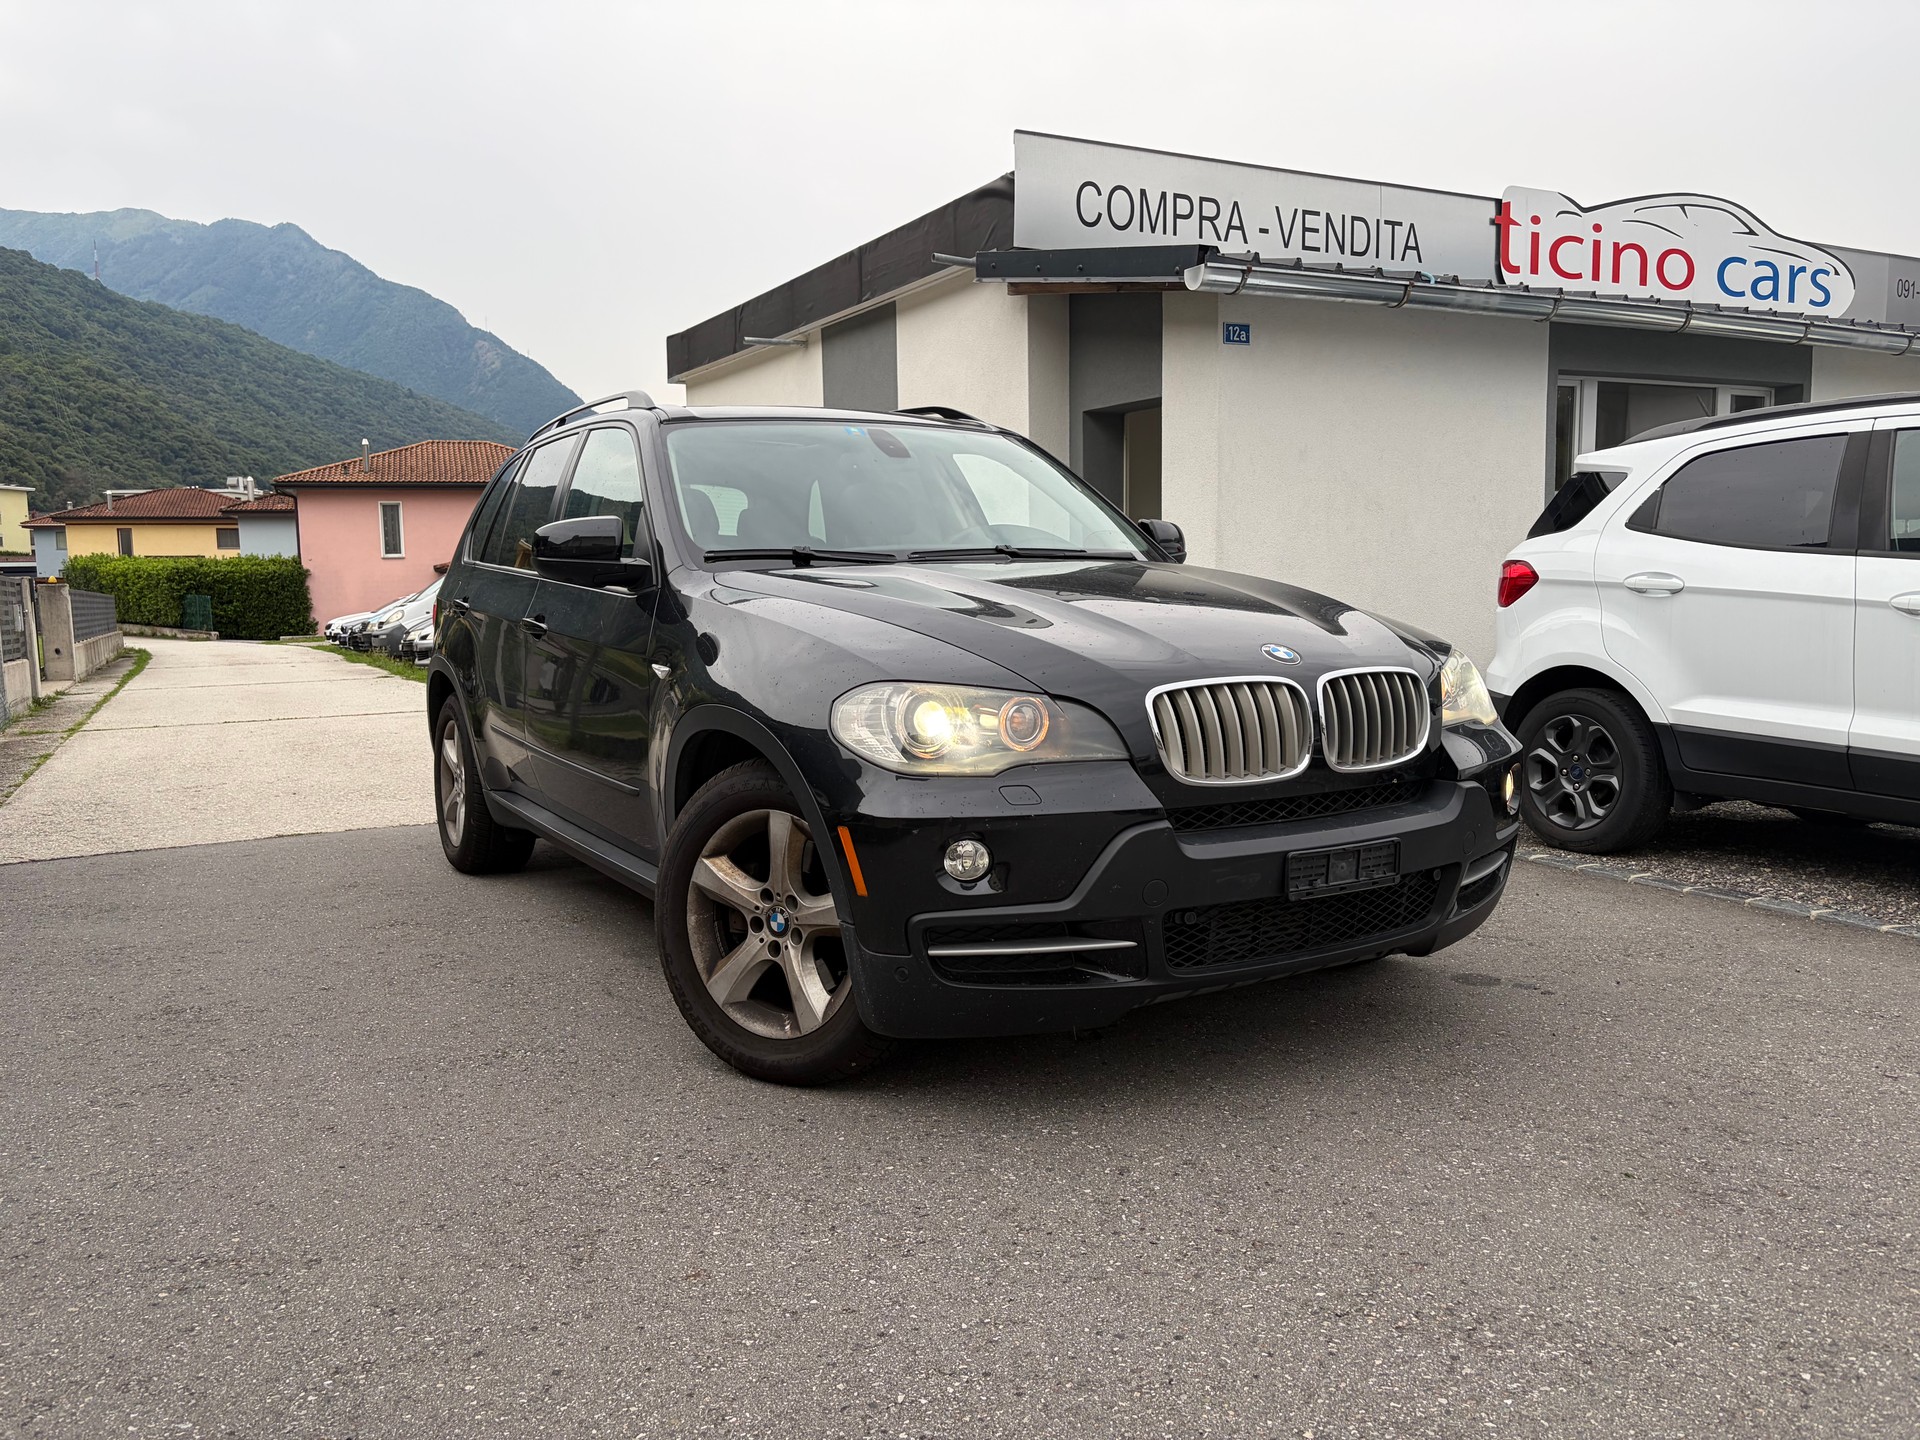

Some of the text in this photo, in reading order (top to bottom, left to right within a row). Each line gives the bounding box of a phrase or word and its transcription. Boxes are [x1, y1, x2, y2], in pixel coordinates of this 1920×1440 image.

[1075, 180, 1249, 244] COMPRA
[1275, 205, 1423, 263] VENDITA
[1494, 200, 1832, 307] ticino cars
[1228, 326, 1247, 341] 12a
